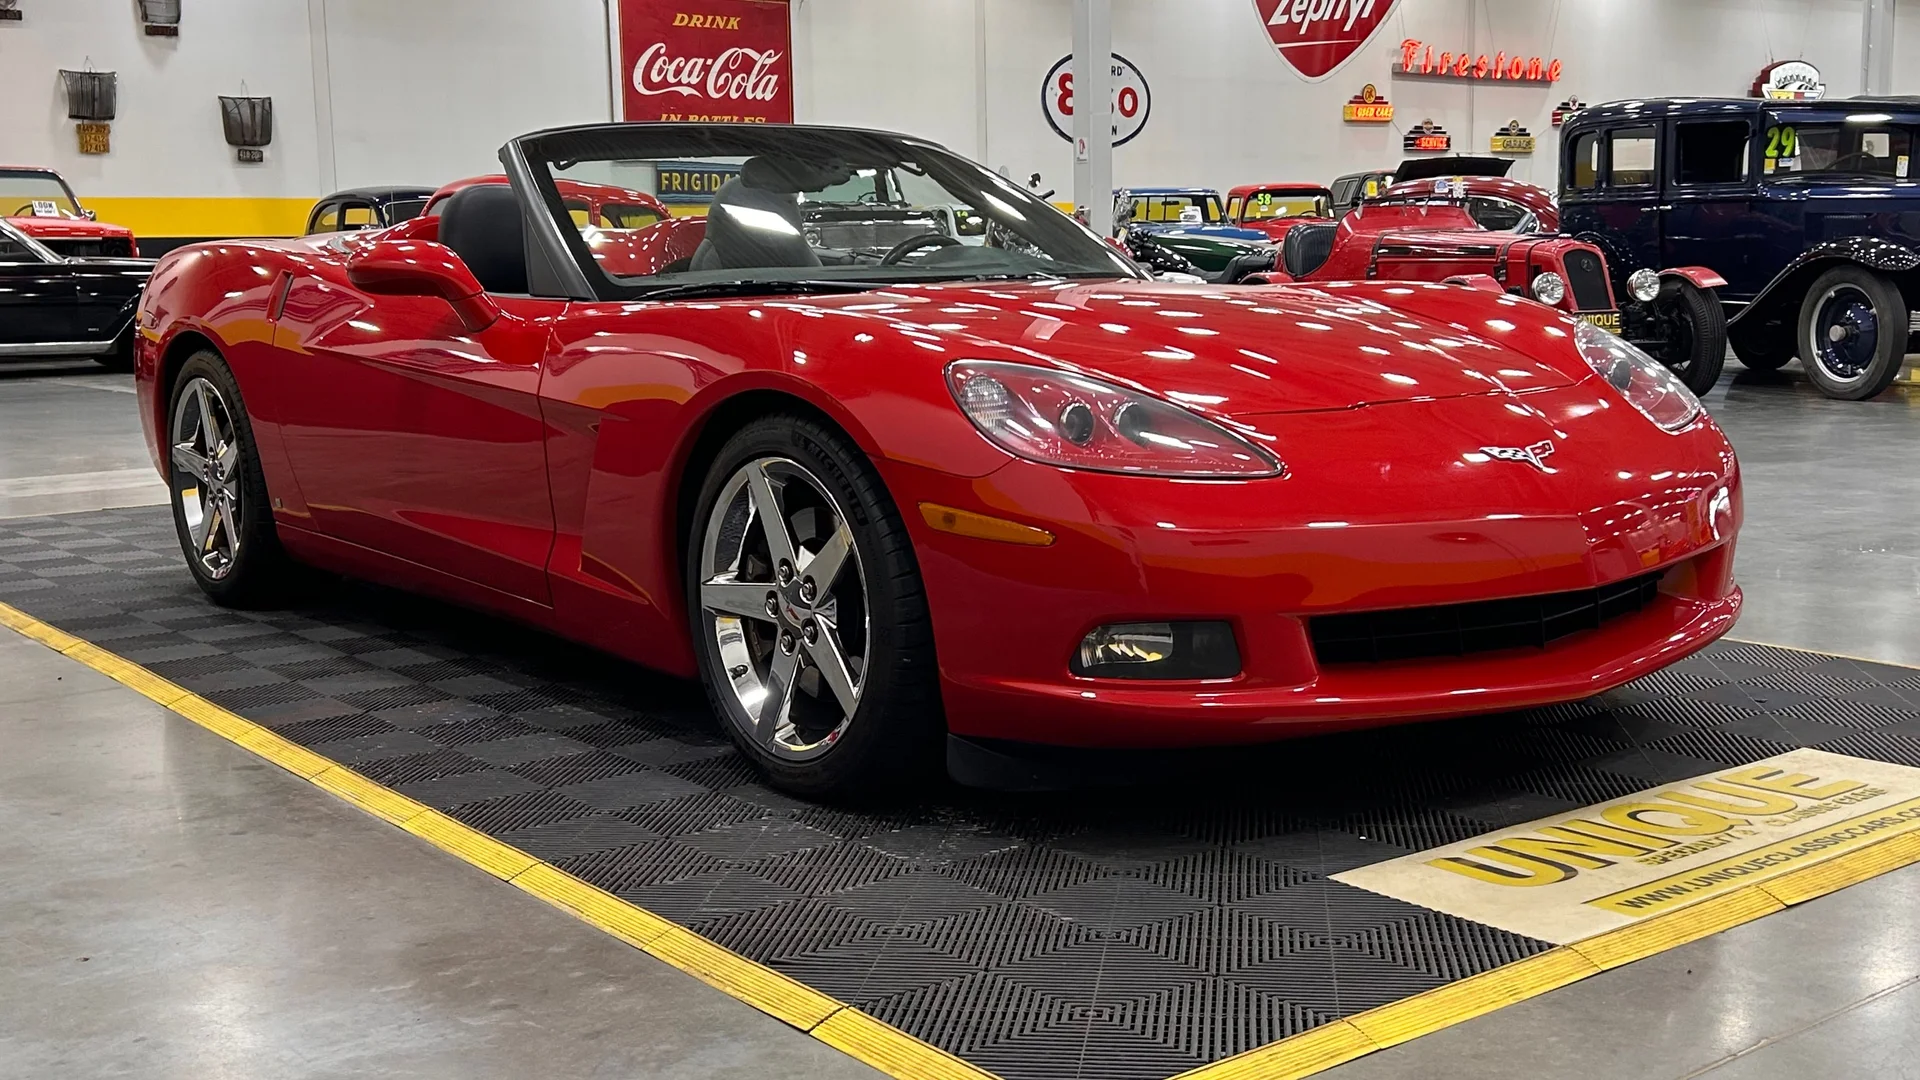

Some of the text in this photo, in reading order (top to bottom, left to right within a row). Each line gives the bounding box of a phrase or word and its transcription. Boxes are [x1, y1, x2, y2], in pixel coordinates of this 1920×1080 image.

[672, 13, 741, 30] DRINK
[633, 42, 783, 101] Coca-Cola
[1400, 38, 1563, 82] Firestone
[1765, 126, 1795, 157] 29
[1257, 193, 1272, 206] 58
[807, 442, 867, 522] MICHELIN
[1424, 765, 1869, 888] UNIQUE
